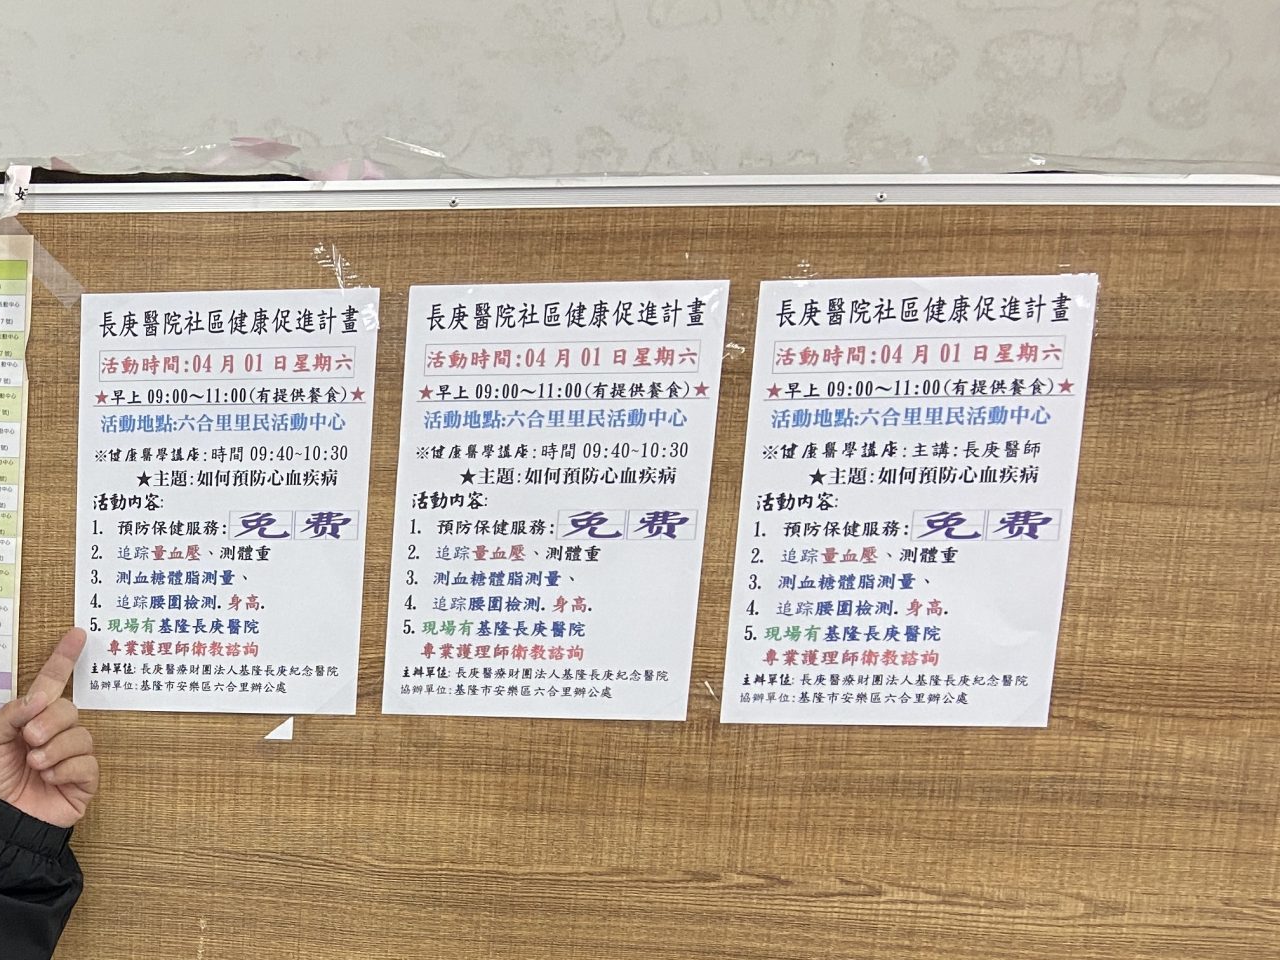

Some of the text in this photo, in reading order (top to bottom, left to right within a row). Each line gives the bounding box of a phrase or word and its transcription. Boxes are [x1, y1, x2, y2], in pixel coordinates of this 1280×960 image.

[427, 297, 706, 331] 長庚醫院社區健康促進計畫
[776, 293, 1071, 327] 長庚醫院社區健康促進計畫
[99, 305, 359, 338] 長庚醫院社區健康促進計畫
[427, 346, 697, 369] 活動時間:04 月 01 日星期六
[776, 342, 1062, 366] 活動時間:04 月 01 日星期六
[102, 353, 353, 375] 活動時間:04 月 01 日星期六
[111, 389, 142, 403] 早上
[435, 384, 469, 399] 早上
[785, 382, 820, 398] 早上
[101, 413, 345, 433] 活動地點:六合里里民活動中心
[424, 408, 687, 429] 活動地點:六合里里民活動中心
[771, 406, 1051, 428] 活動地點:六合里里民活動中心
[94, 493, 163, 511] 活動內容:
[412, 491, 487, 509] 活動內容:
[757, 492, 838, 511] 活動內容:
[93, 520, 103, 534] 1.
[118, 520, 226, 536] 預防保健服務:
[410, 519, 421, 534] 1.
[437, 519, 554, 535] 預防保健服務:
[754, 521, 766, 537] 1.
[784, 520, 908, 537] 預防保健服務:
[91, 545, 102, 559] 2.
[408, 545, 419, 559] 2.
[751, 548, 763, 563] 2.
[91, 570, 102, 584] 3.
[406, 570, 418, 585] 3.
[749, 574, 761, 590] 3.
[90, 593, 101, 608] 4.
[227, 594, 264, 611] 身高.
[405, 595, 416, 610] 4.
[552, 596, 592, 613] 身高.
[746, 600, 759, 615] 4.
[906, 599, 948, 616] 身高.
[90, 617, 259, 635] 5. 現場有基隆長庚醫院
[403, 619, 585, 638] 5. 現場有基隆長庚醫院
[744, 625, 941, 642] 5. 現場有基隆長庚醫院
